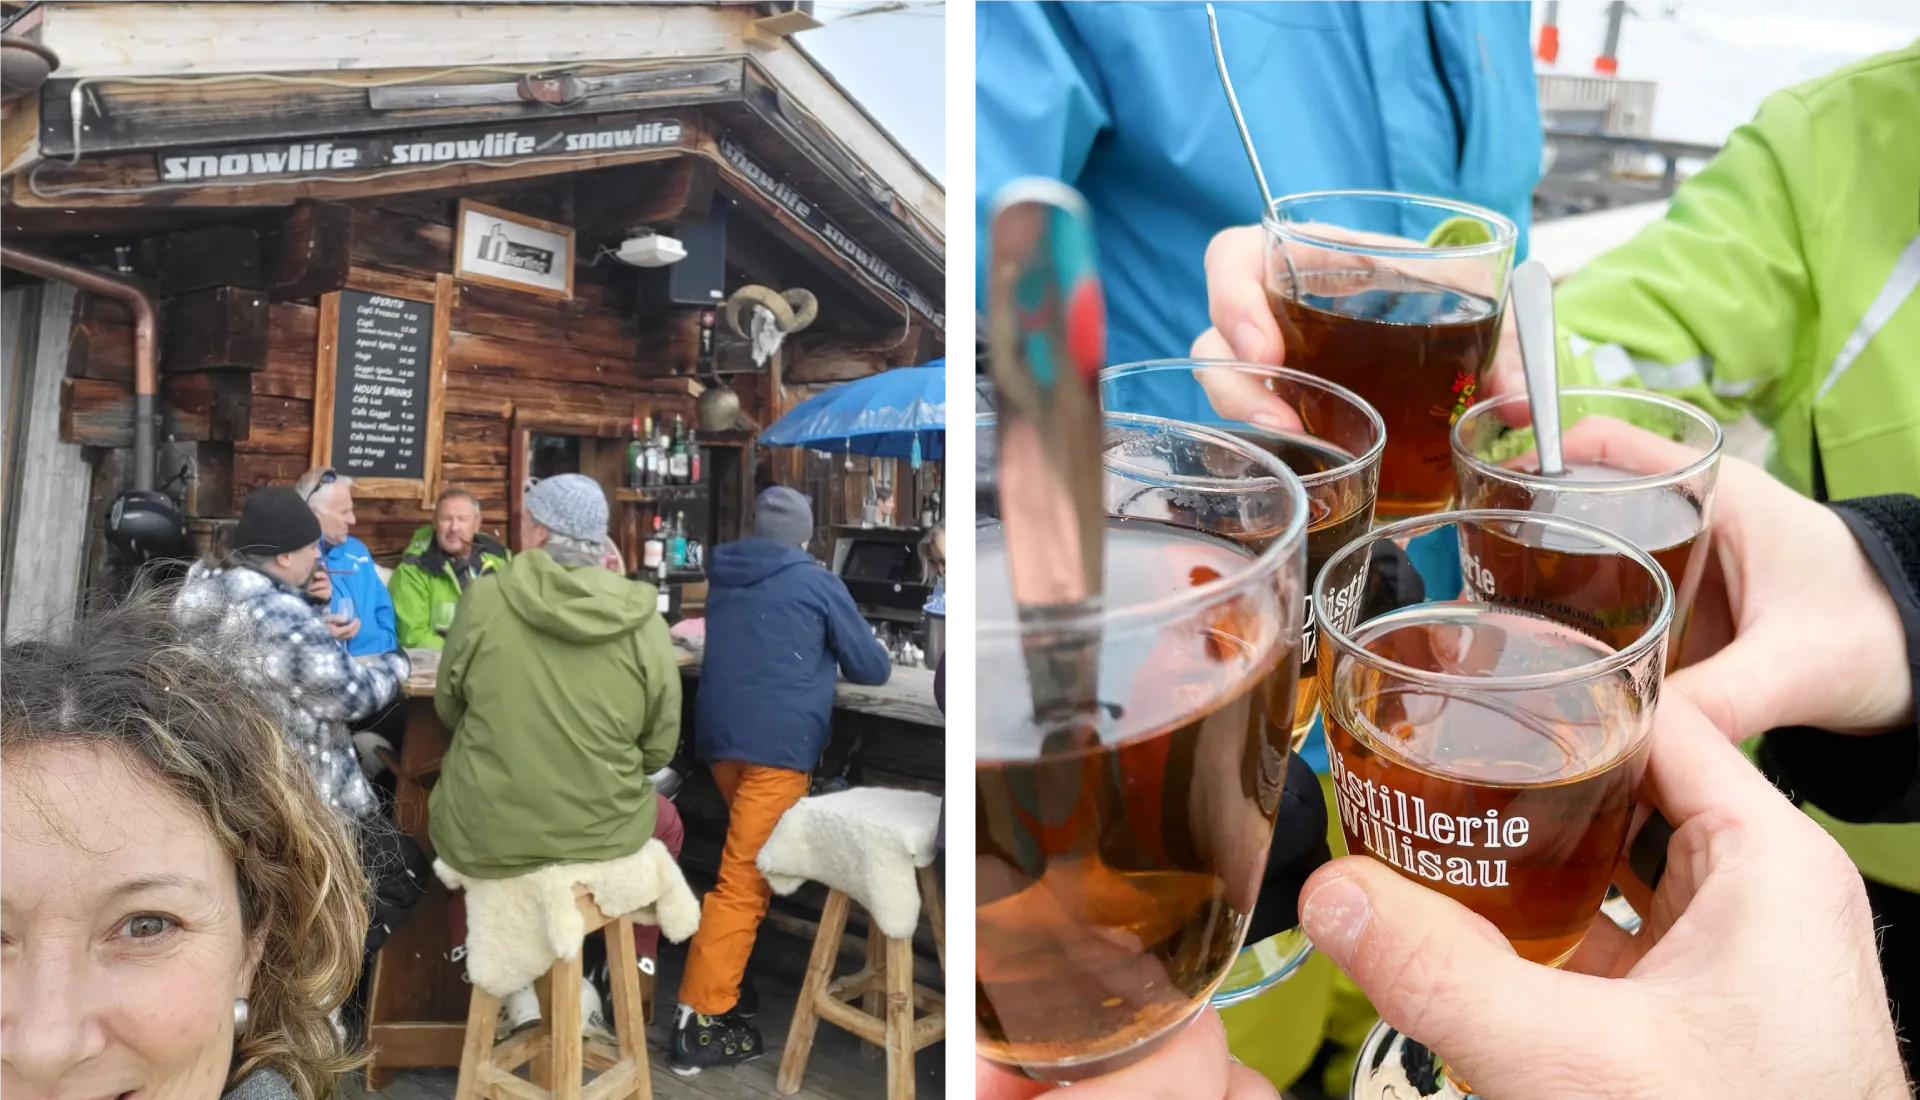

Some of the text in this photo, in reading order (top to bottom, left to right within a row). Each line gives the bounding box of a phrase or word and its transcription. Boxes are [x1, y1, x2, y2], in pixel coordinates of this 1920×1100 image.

[164, 122, 681, 180] snowlife snowlife snowlife
[721, 142, 812, 219] snowlife
[822, 222, 898, 286] snowlife
[353, 384, 413, 399] HOUSE DRINKS
[1334, 780, 1510, 888] Willisau
